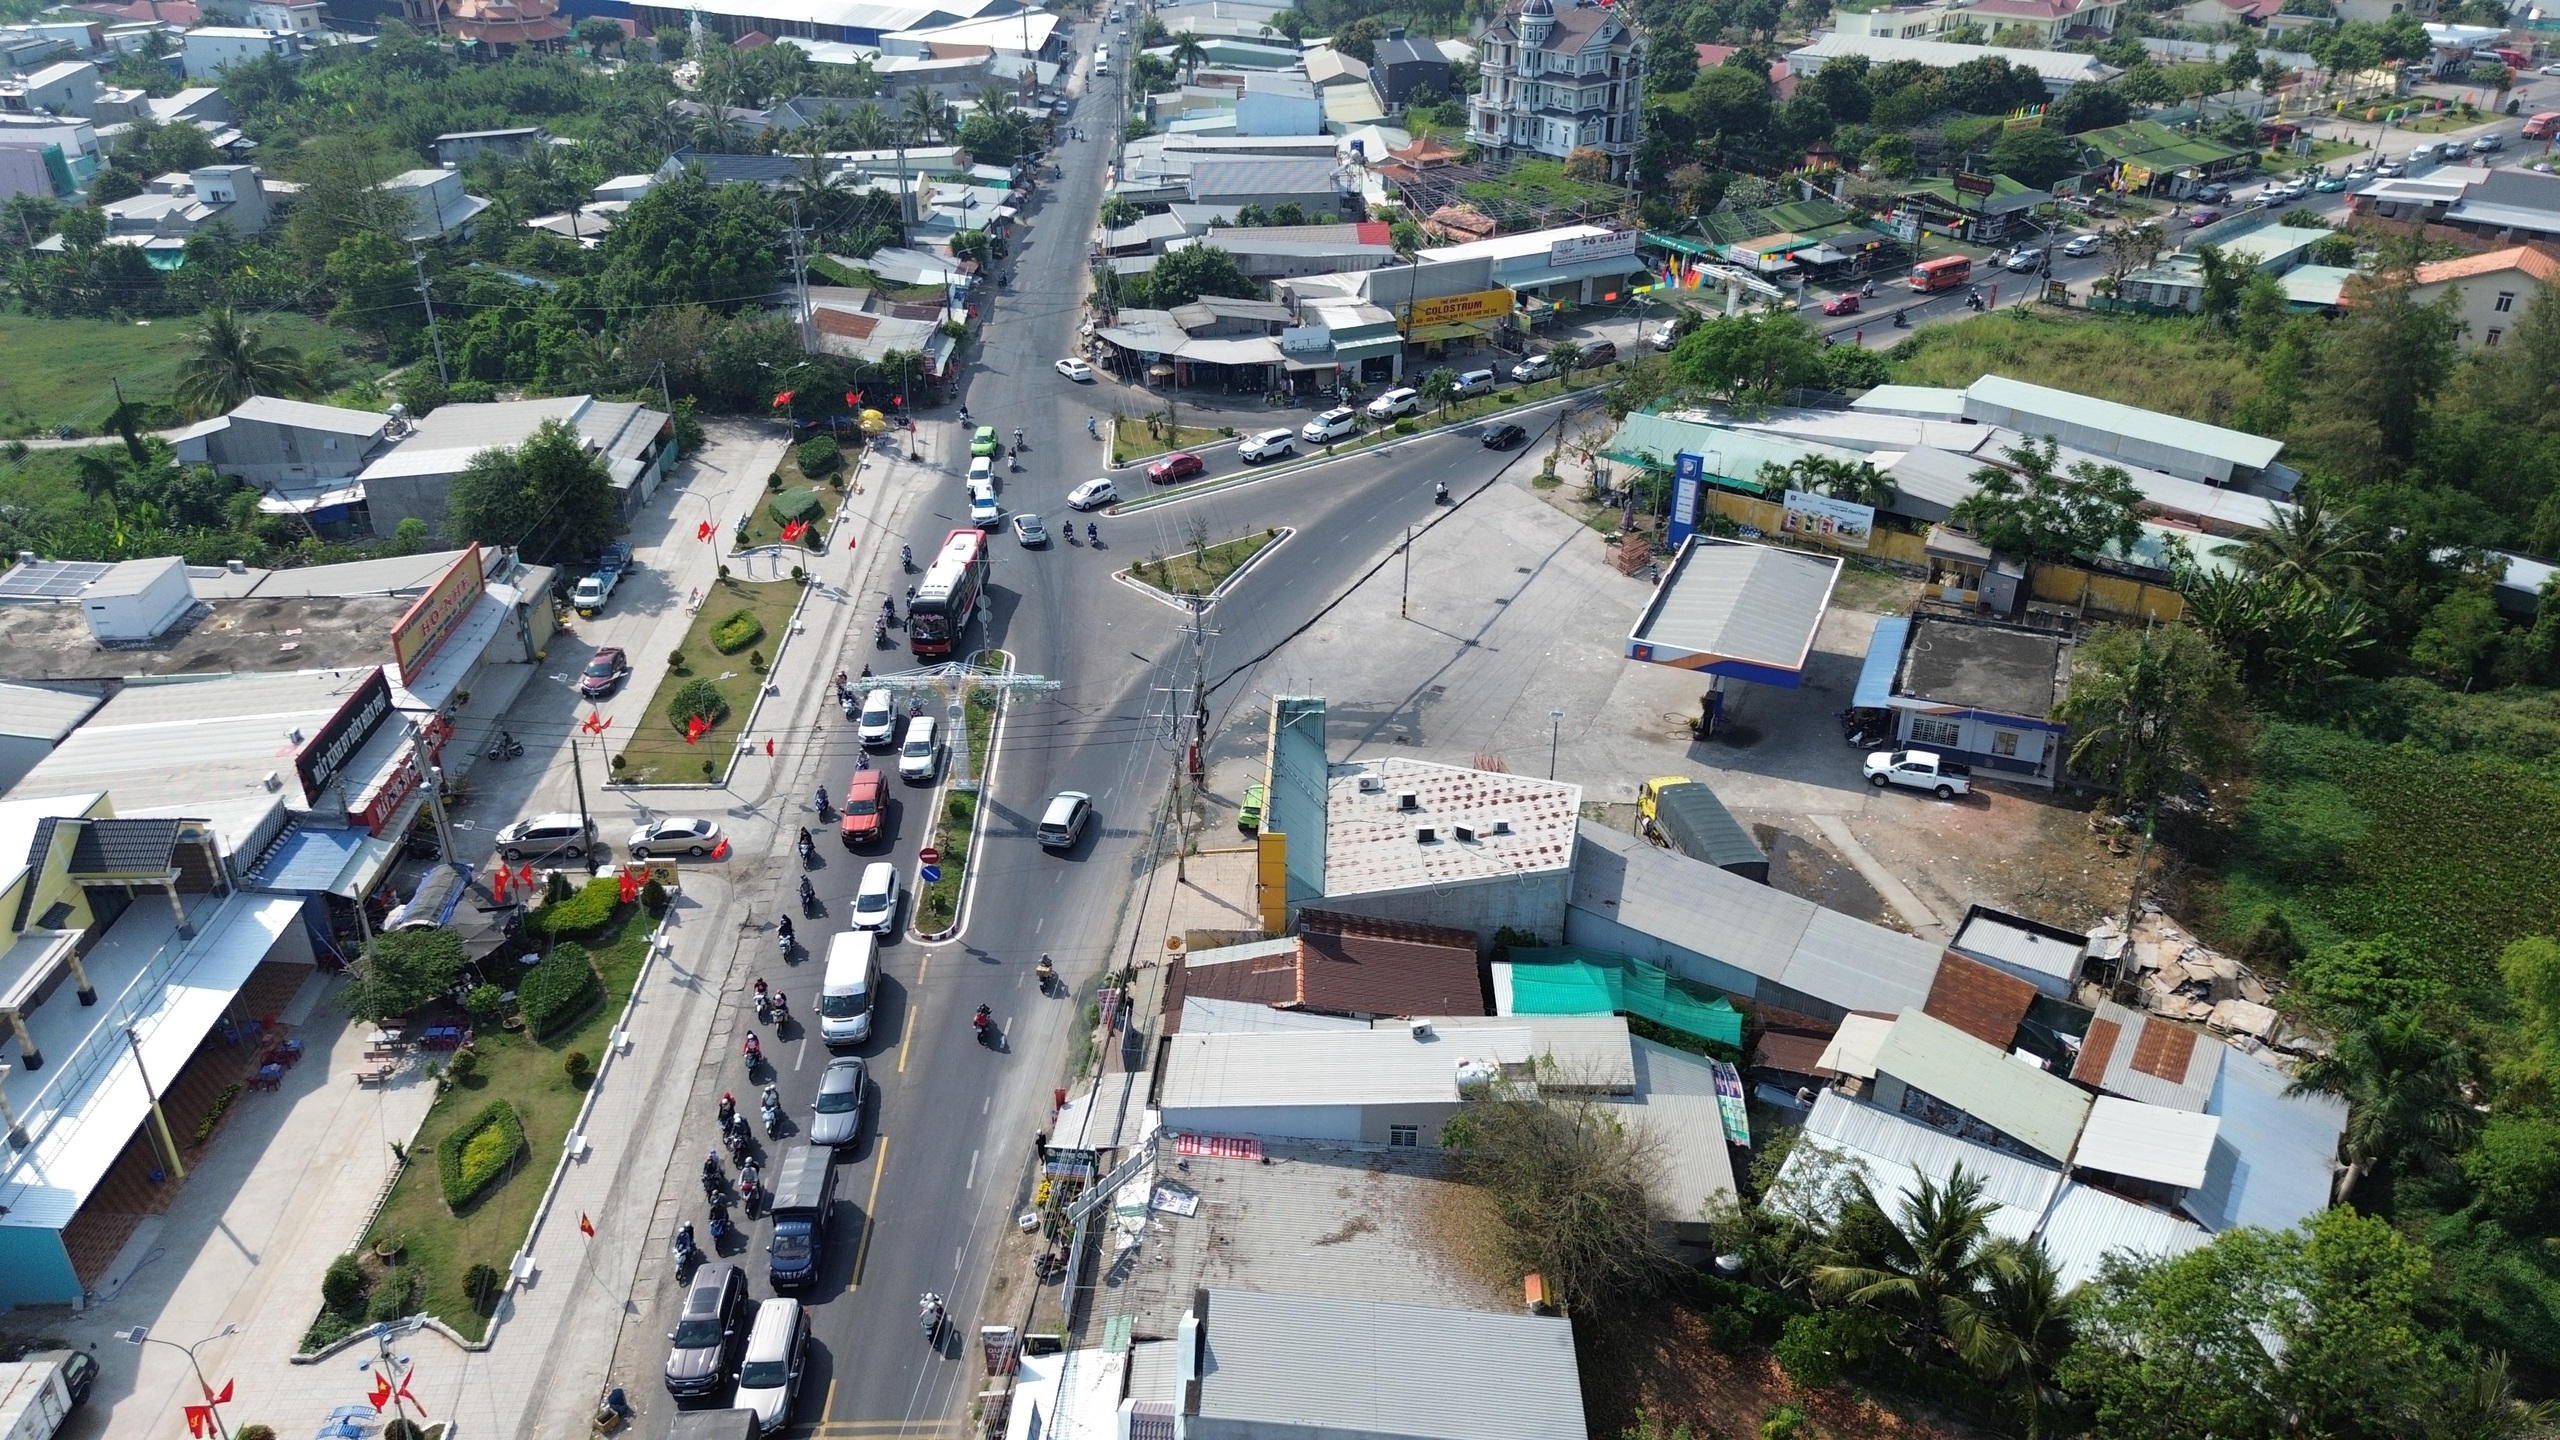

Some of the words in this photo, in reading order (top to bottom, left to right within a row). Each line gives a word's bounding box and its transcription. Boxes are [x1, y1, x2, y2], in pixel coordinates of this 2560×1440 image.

[1426, 301, 1483, 316] COLOSTRUM
[312, 752, 330, 785] MẮT
[326, 742, 344, 770] KÍNH
[348, 717, 365, 745] ĐIỆN
[360, 703, 377, 731] BIÊN
